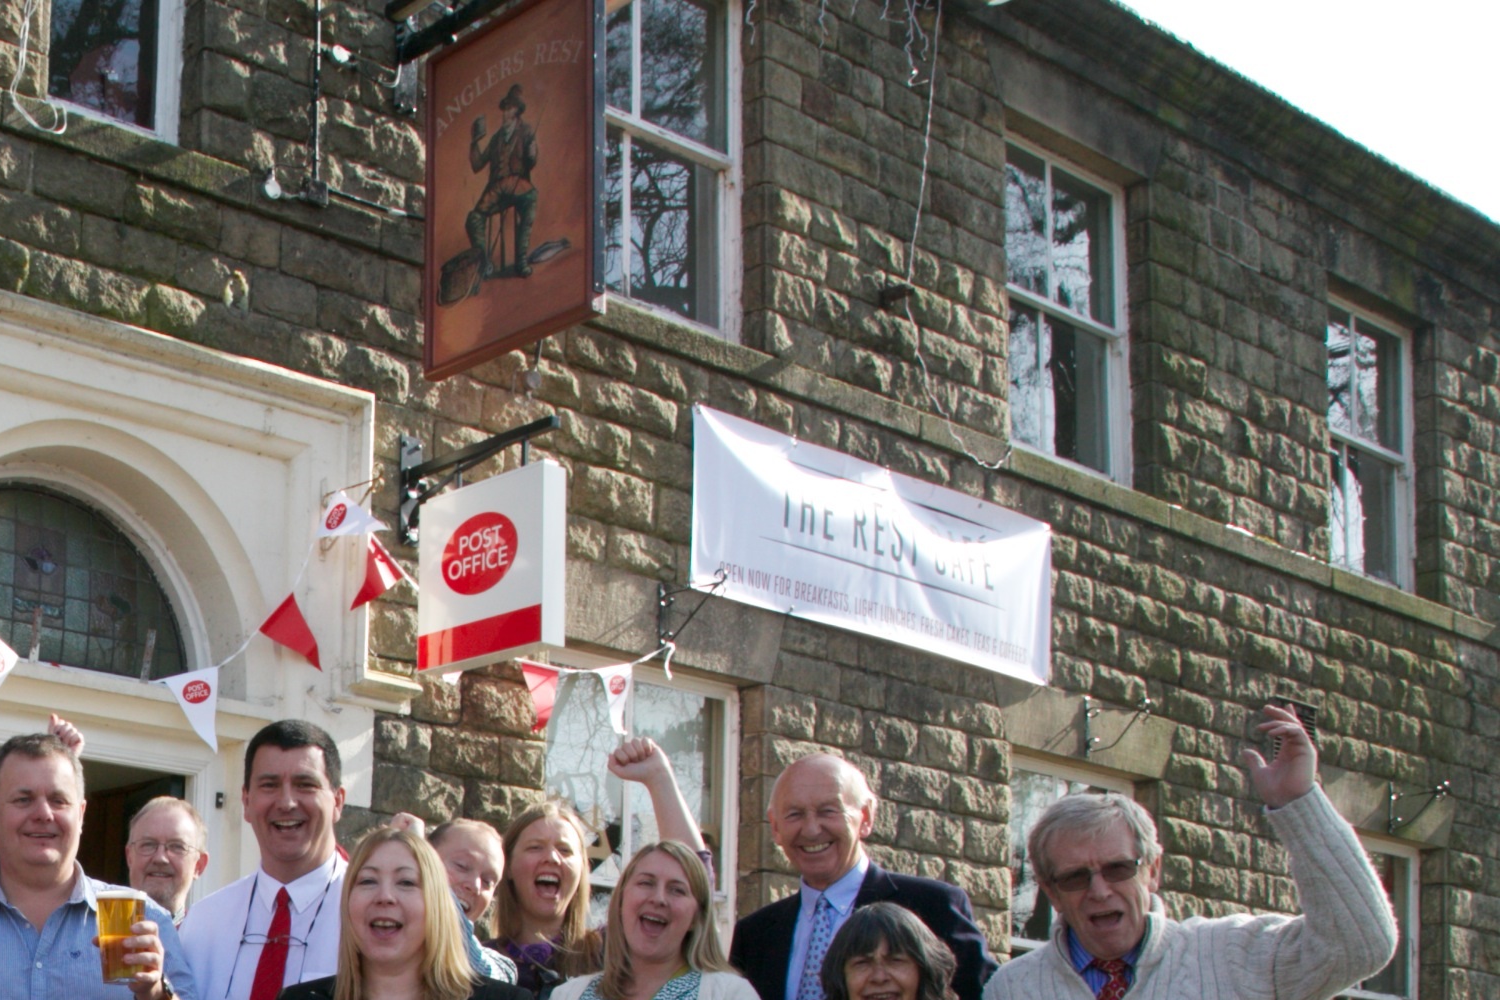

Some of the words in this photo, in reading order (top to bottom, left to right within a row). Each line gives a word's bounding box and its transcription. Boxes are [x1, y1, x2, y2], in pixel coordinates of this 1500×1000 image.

[435, 50, 524, 138] ANGLERS
[533, 39, 584, 66] REST
[459, 524, 503, 555] POST
[783, 491, 835, 541] THE
[853, 501, 918, 568] REST
[448, 545, 508, 580] OFFICE
[719, 561, 744, 585] OPEN
[748, 568, 771, 592] NOW
[774, 575, 791, 597] FOR
[854, 596, 879, 619] LIGHT
